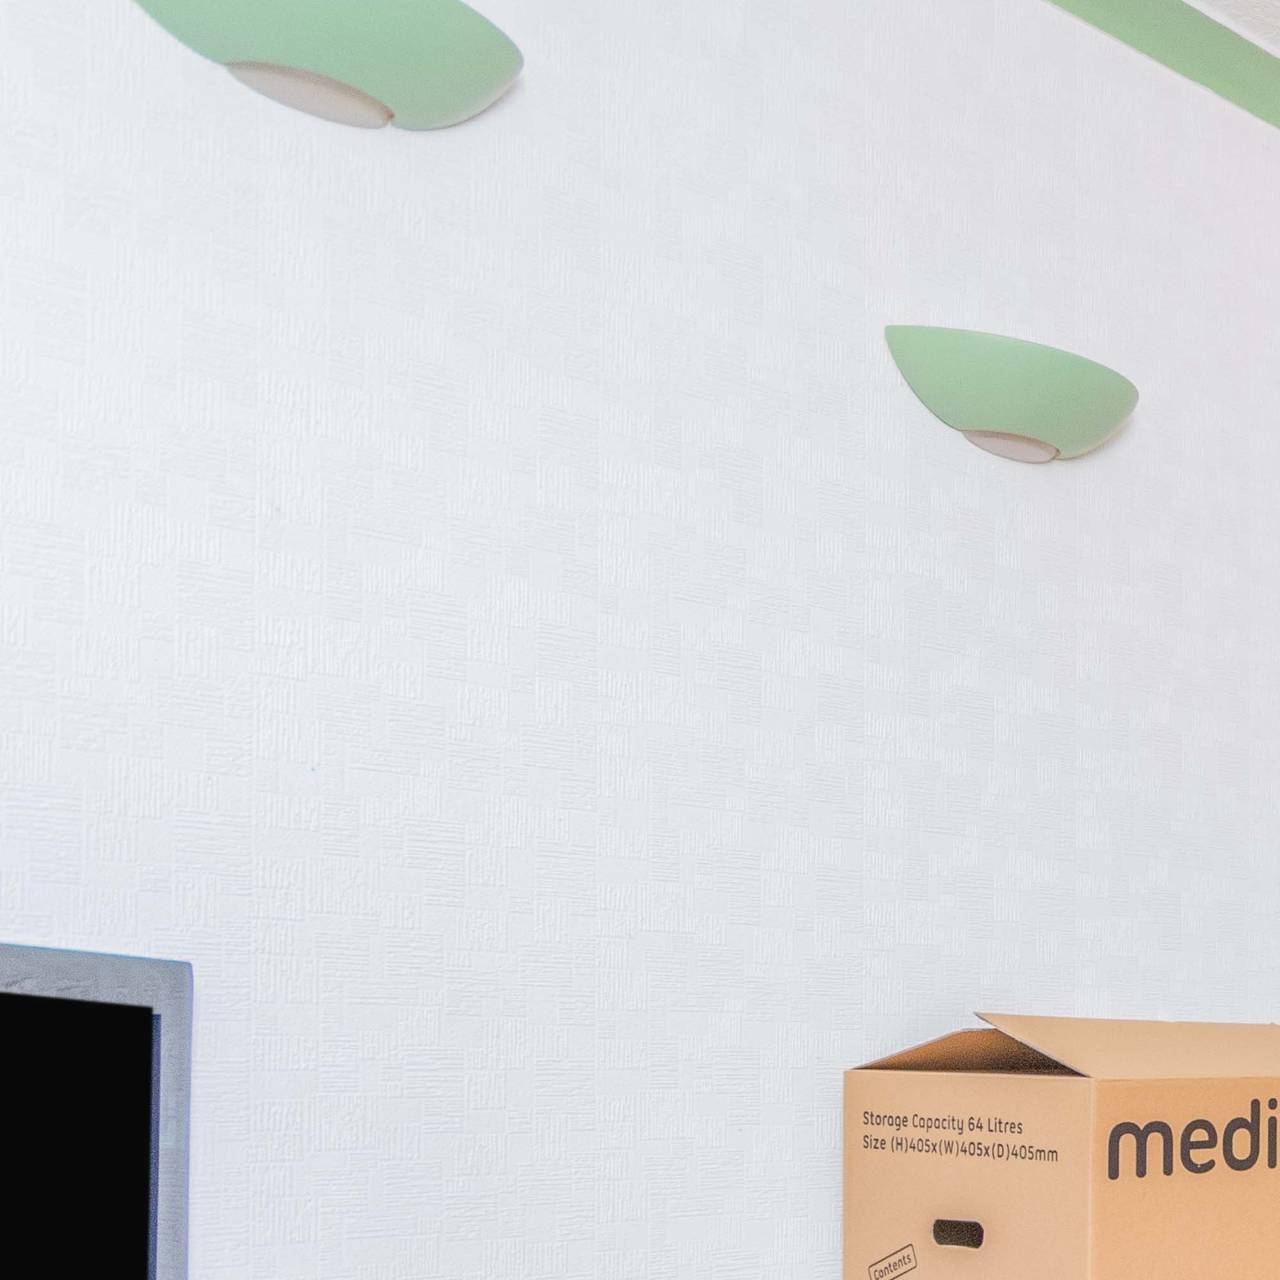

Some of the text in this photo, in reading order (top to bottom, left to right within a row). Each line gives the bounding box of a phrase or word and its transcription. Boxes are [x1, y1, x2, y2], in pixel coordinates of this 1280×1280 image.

[863, 1111, 1023, 1135] Storage Capacity 64 Litres
[863, 1135, 1059, 1162] Size (H)405x(W)405x(D)405mm
[873, 1254, 912, 1280] Contents
